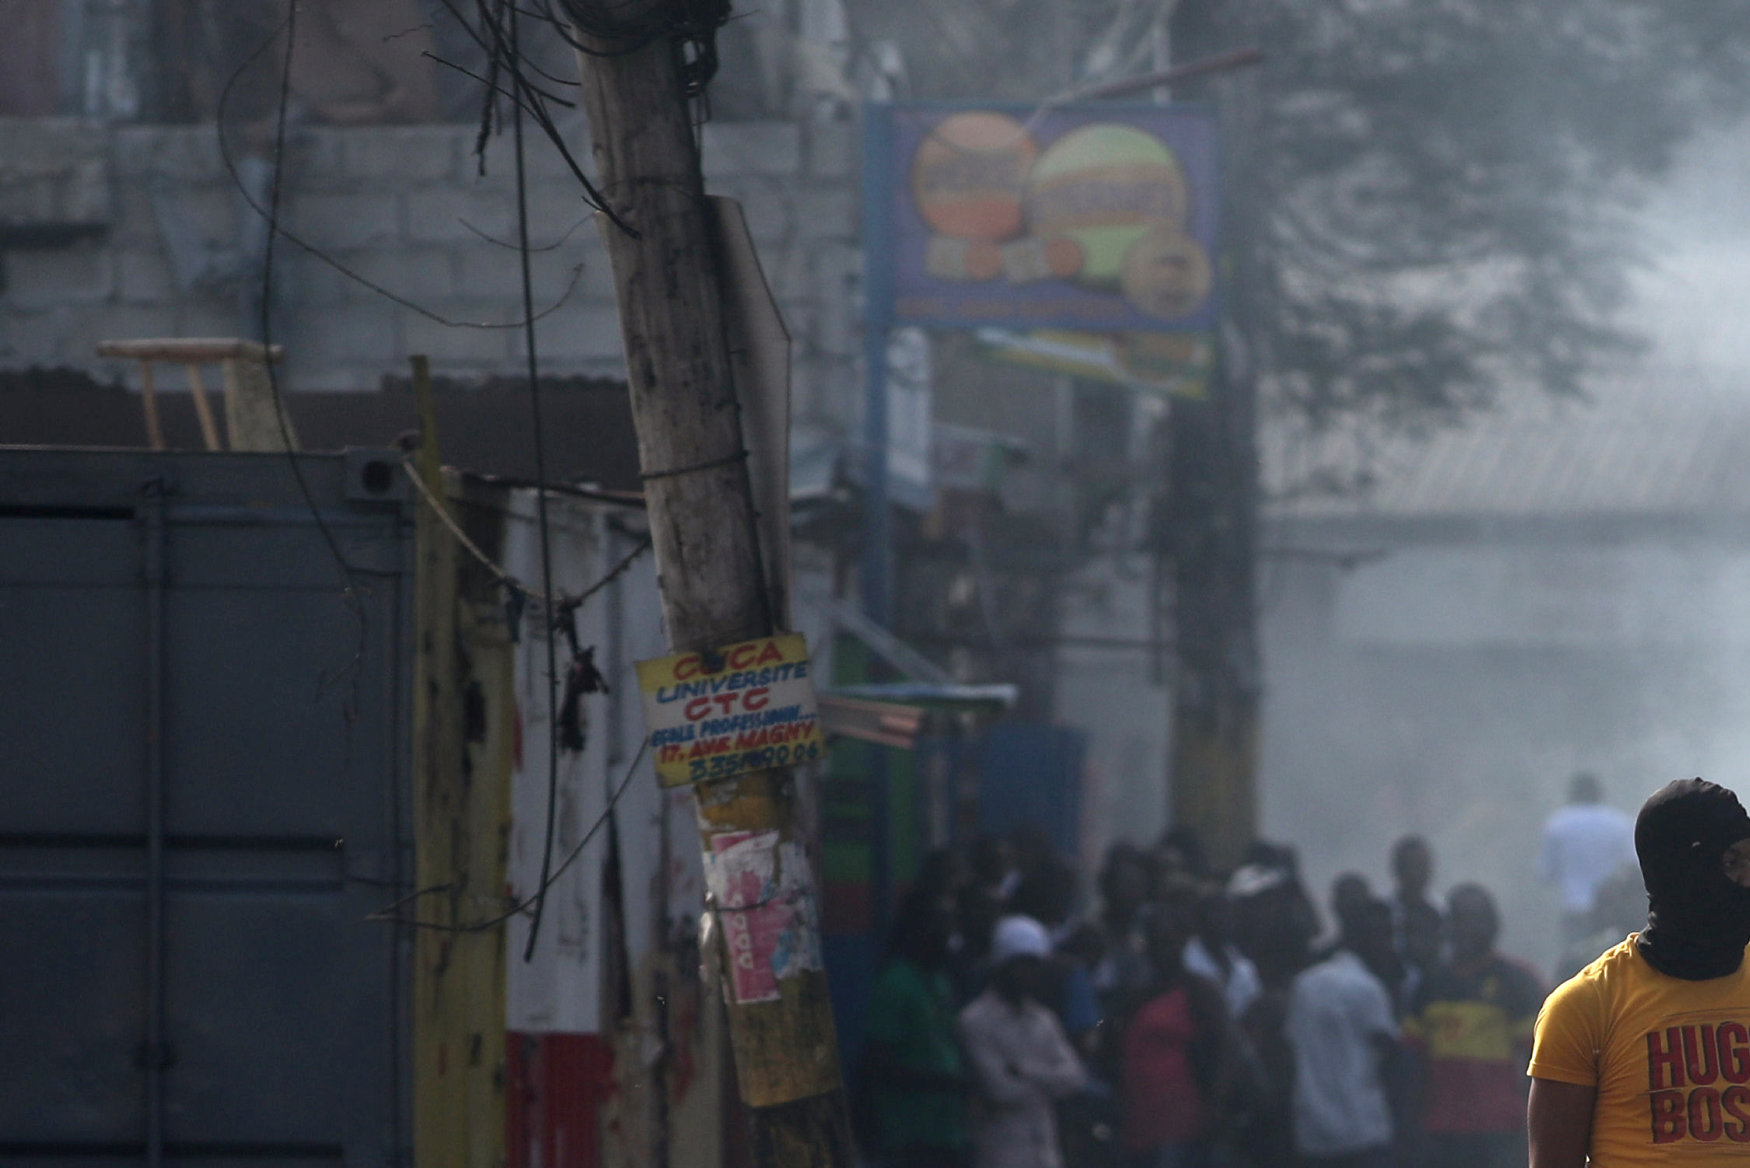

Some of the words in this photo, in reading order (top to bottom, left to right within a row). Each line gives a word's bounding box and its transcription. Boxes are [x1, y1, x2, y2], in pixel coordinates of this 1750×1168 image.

[673, 642, 783, 681] CCA
[656, 660, 808, 704] UNIVERSITE
[684, 687, 770, 721] CTC
[736, 721, 815, 751] MAGNY
